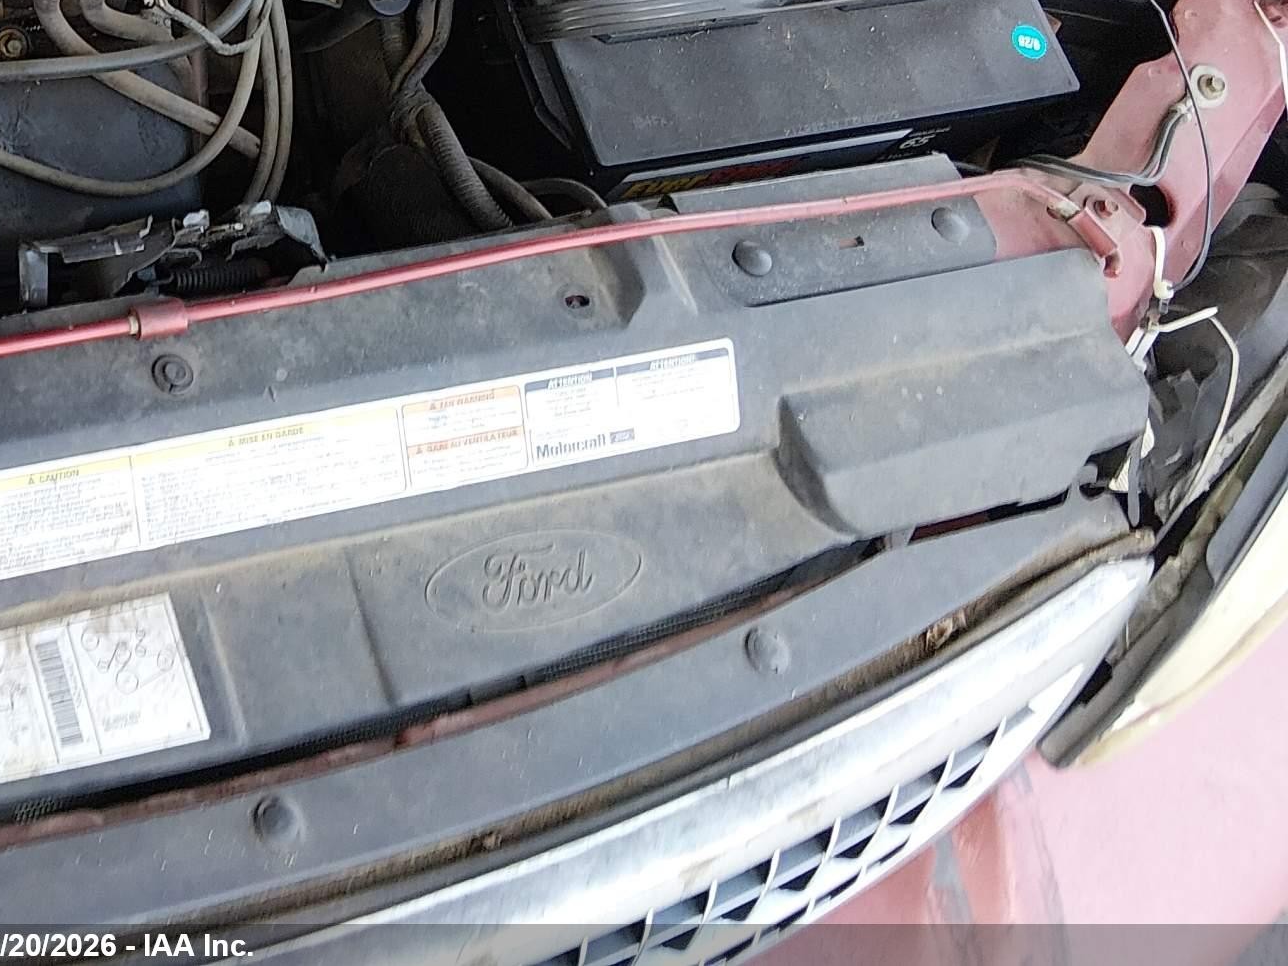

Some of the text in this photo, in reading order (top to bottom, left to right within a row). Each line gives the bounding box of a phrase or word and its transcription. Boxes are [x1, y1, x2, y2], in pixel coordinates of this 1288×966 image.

[238, 426, 304, 445] MISE EN GARDE
[536, 433, 606, 459] Motorcraft
[39, 469, 80, 484] CAUTION
[482, 542, 595, 614] Ford
